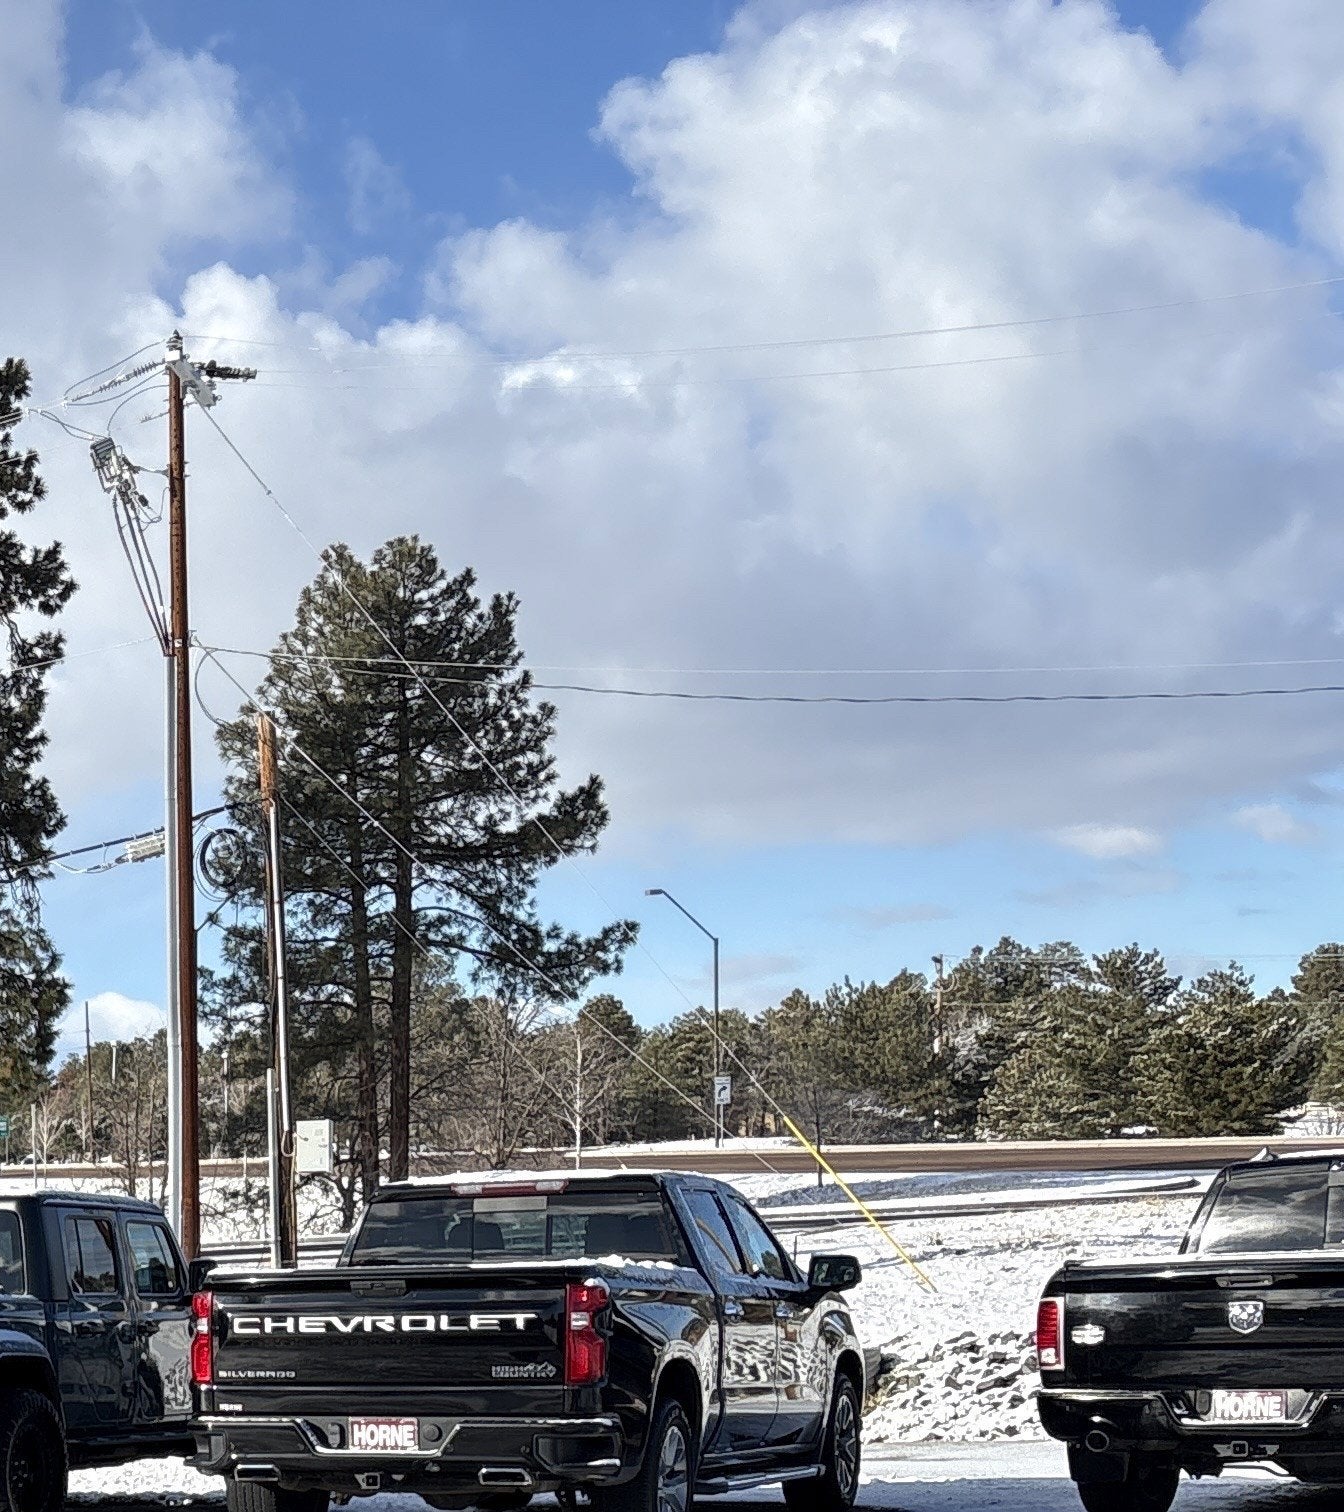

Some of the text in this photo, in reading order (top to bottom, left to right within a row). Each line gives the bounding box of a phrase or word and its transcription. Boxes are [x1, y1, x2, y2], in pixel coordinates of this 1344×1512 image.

[233, 1313, 538, 1335] CHEVROLET
[218, 1370, 297, 1378] SILVERADO
[1215, 1395, 1282, 1418] HORNE
[353, 1423, 415, 1447] HORNE
